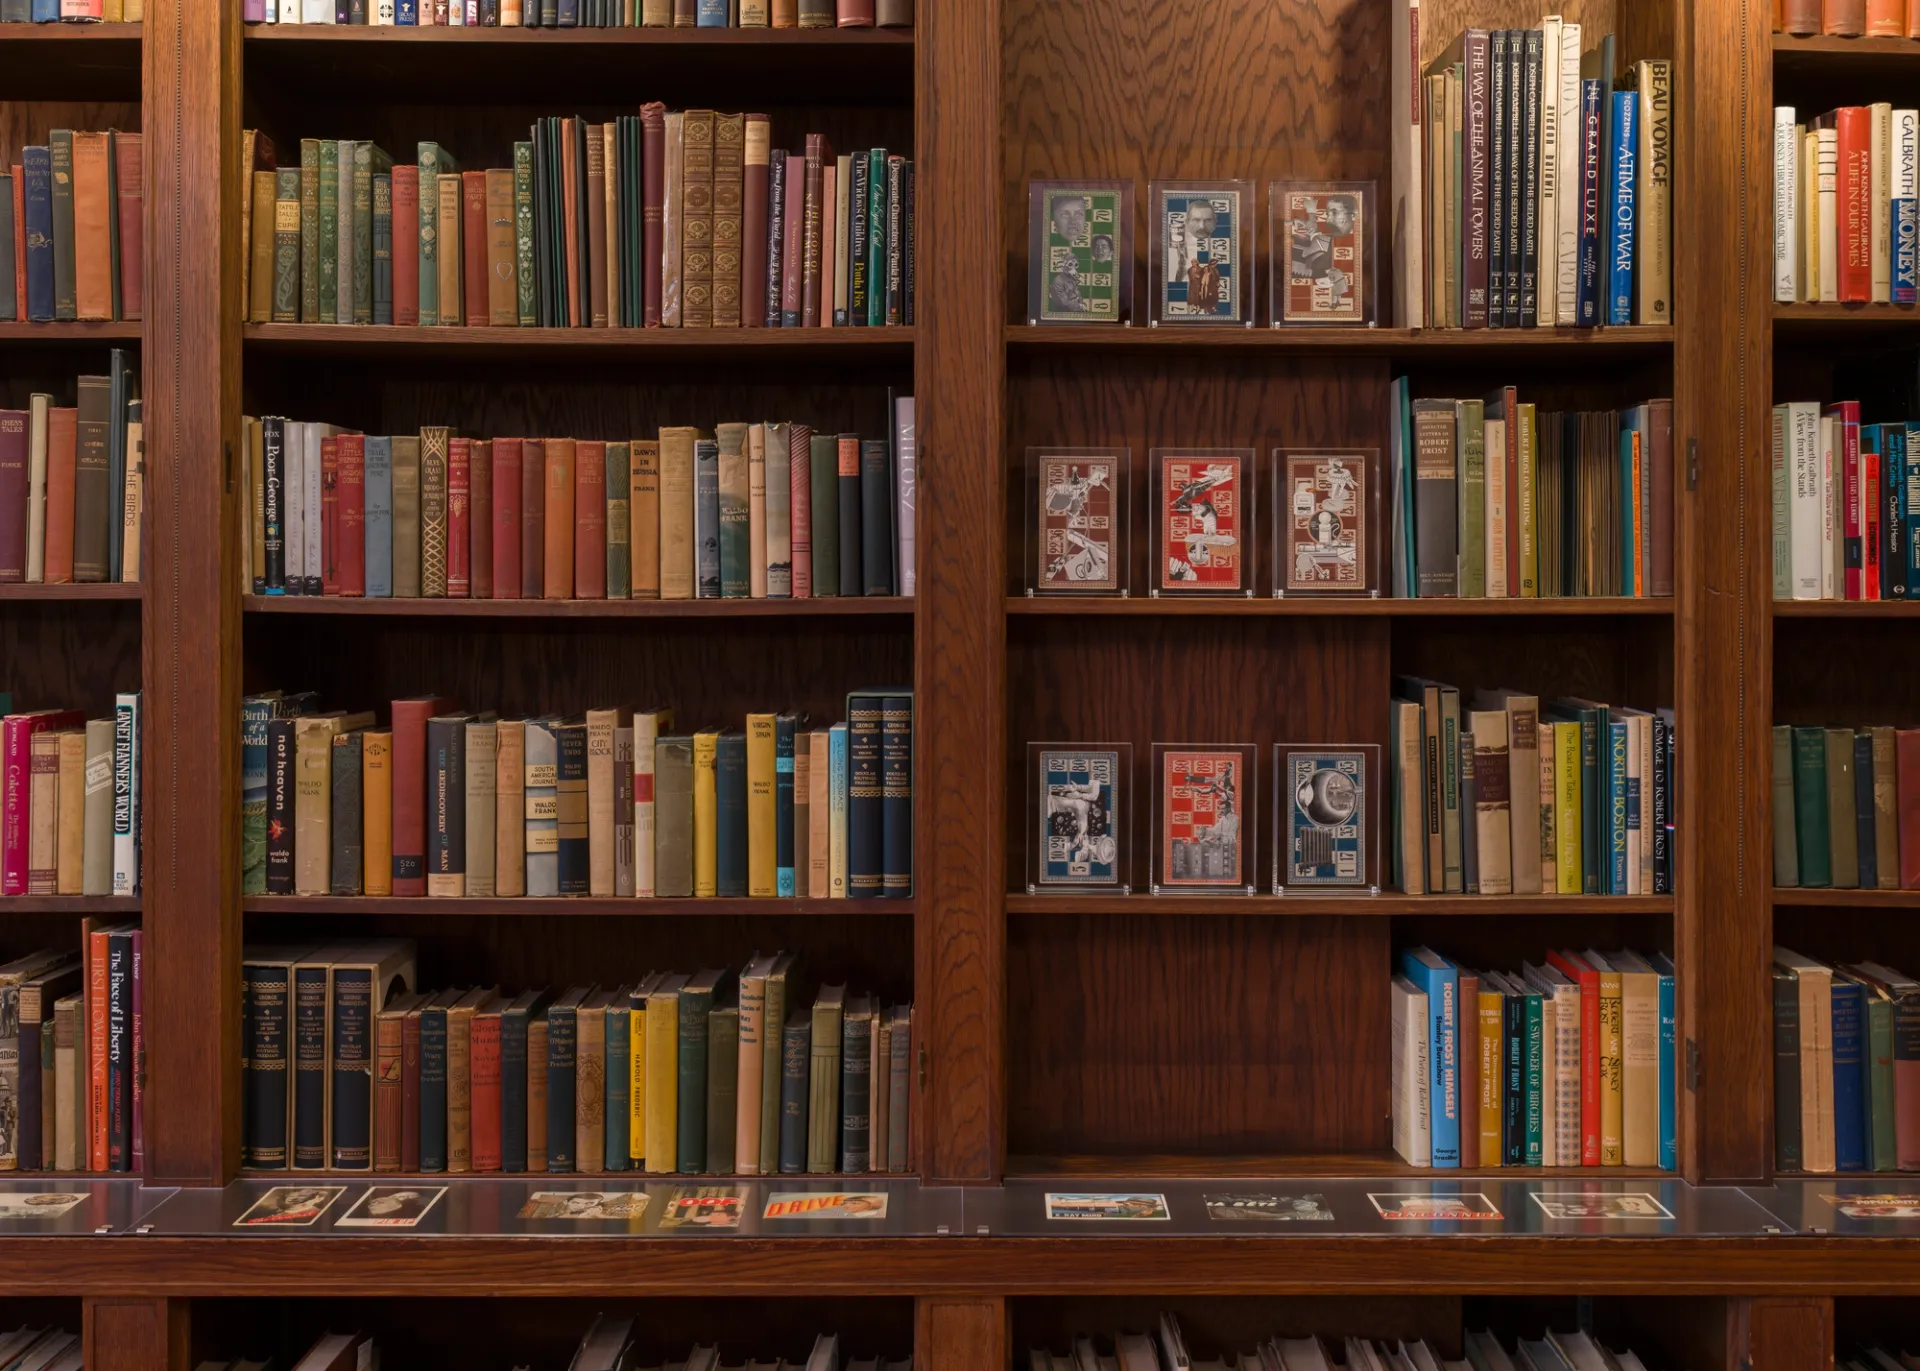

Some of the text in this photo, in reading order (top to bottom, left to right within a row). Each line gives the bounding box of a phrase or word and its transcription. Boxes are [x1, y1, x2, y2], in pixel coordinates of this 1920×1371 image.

[1651, 62, 1667, 112] BEAU
[1472, 44, 1484, 260] THE WAY OF THE ANIMAL POWERS
[1544, 105, 1555, 199] avedon baldwin
[1651, 116, 1667, 187] VOYAGE
[1585, 115, 1598, 234] GRAND LUXE
[1617, 160, 1633, 204] TIME
[1849, 163, 1859, 187] LIFE
[1776, 164, 1786, 240] THROUGH ECONOMIC
[1849, 188, 1859, 200] IN
[1860, 150, 1868, 267] JOHN KENNETH GALBRAITH
[1898, 115, 1915, 286] GALBRAITH MONEY
[1094, 210, 1112, 221] 70
[1526, 199, 1536, 255] SEEDED EARTH
[1617, 206, 1633, 230] OF
[1849, 201, 1859, 228] OUR
[811, 232, 819, 256] GOD
[855, 214, 866, 256] Children
[1213, 239, 1229, 250] 53
[1335, 247, 1353, 259] 49
[1616, 232, 1632, 272] WAR
[1849, 234, 1859, 267] TIMES
[853, 262, 865, 308] Paula Fox
[1093, 274, 1110, 286] 29
[1049, 465, 1065, 477] 80
[1520, 416, 1531, 526] ROBERT WRITING
[1796, 437, 1806, 499] from Stands
[1805, 411, 1817, 497] John Kenneth Galbraith
[126, 469, 136, 527] THE BIRDS
[266, 445, 280, 522] Poor George
[1214, 491, 1230, 503] 24
[1091, 517, 1107, 528] 46
[1172, 517, 1188, 528] 46
[1214, 504, 1230, 516] 39
[1048, 529, 1065, 541] 36
[242, 710, 268, 720] Birth
[589, 748, 612, 756] BLOCK
[591, 739, 608, 748] CITY
[1613, 737, 1625, 785] NORTH
[115, 709, 130, 832] JANET FLANNER'S WORLD
[276, 735, 287, 811] not heaven
[1049, 760, 1065, 772] 82
[1072, 760, 1088, 772] 80
[1091, 760, 1107, 771] 81
[1196, 760, 1212, 772] 89
[1299, 761, 1315, 772] 83
[1566, 730, 1576, 803] The Road not Taken
[8, 764, 20, 811] Colette
[1655, 720, 1665, 892] HOMAGE TO ROBERT FROST FSG
[1339, 826, 1355, 837] 35
[1613, 797, 1625, 853] BOSTON
[400, 859, 416, 867] 520
[1615, 856, 1624, 882] Poems
[92, 957, 105, 1079] FIRST FLOWERING
[110, 950, 124, 1064] The Face of Liberty
[1600, 996, 1610, 1025] FROST
[1610, 997, 1621, 1034] ROBERT
[1434, 1015, 1443, 1086] Stanley Burnshaw
[1444, 982, 1455, 1119] ROBERT FROST HIMSELF
[1511, 1037, 1519, 1091] ROBERT FROST
[1530, 1025, 1539, 1071] SWINGER
[1530, 1074, 1539, 1088] OF
[1600, 1056, 1610, 1078] COX
[1610, 1057, 1621, 1093] SIDNEY
[1419, 1112, 1428, 1131] Frost
[1530, 1090, 1539, 1133] BIRCHES
[679, 1196, 741, 1207] OOF
[767, 1194, 845, 1217] DRIVE
